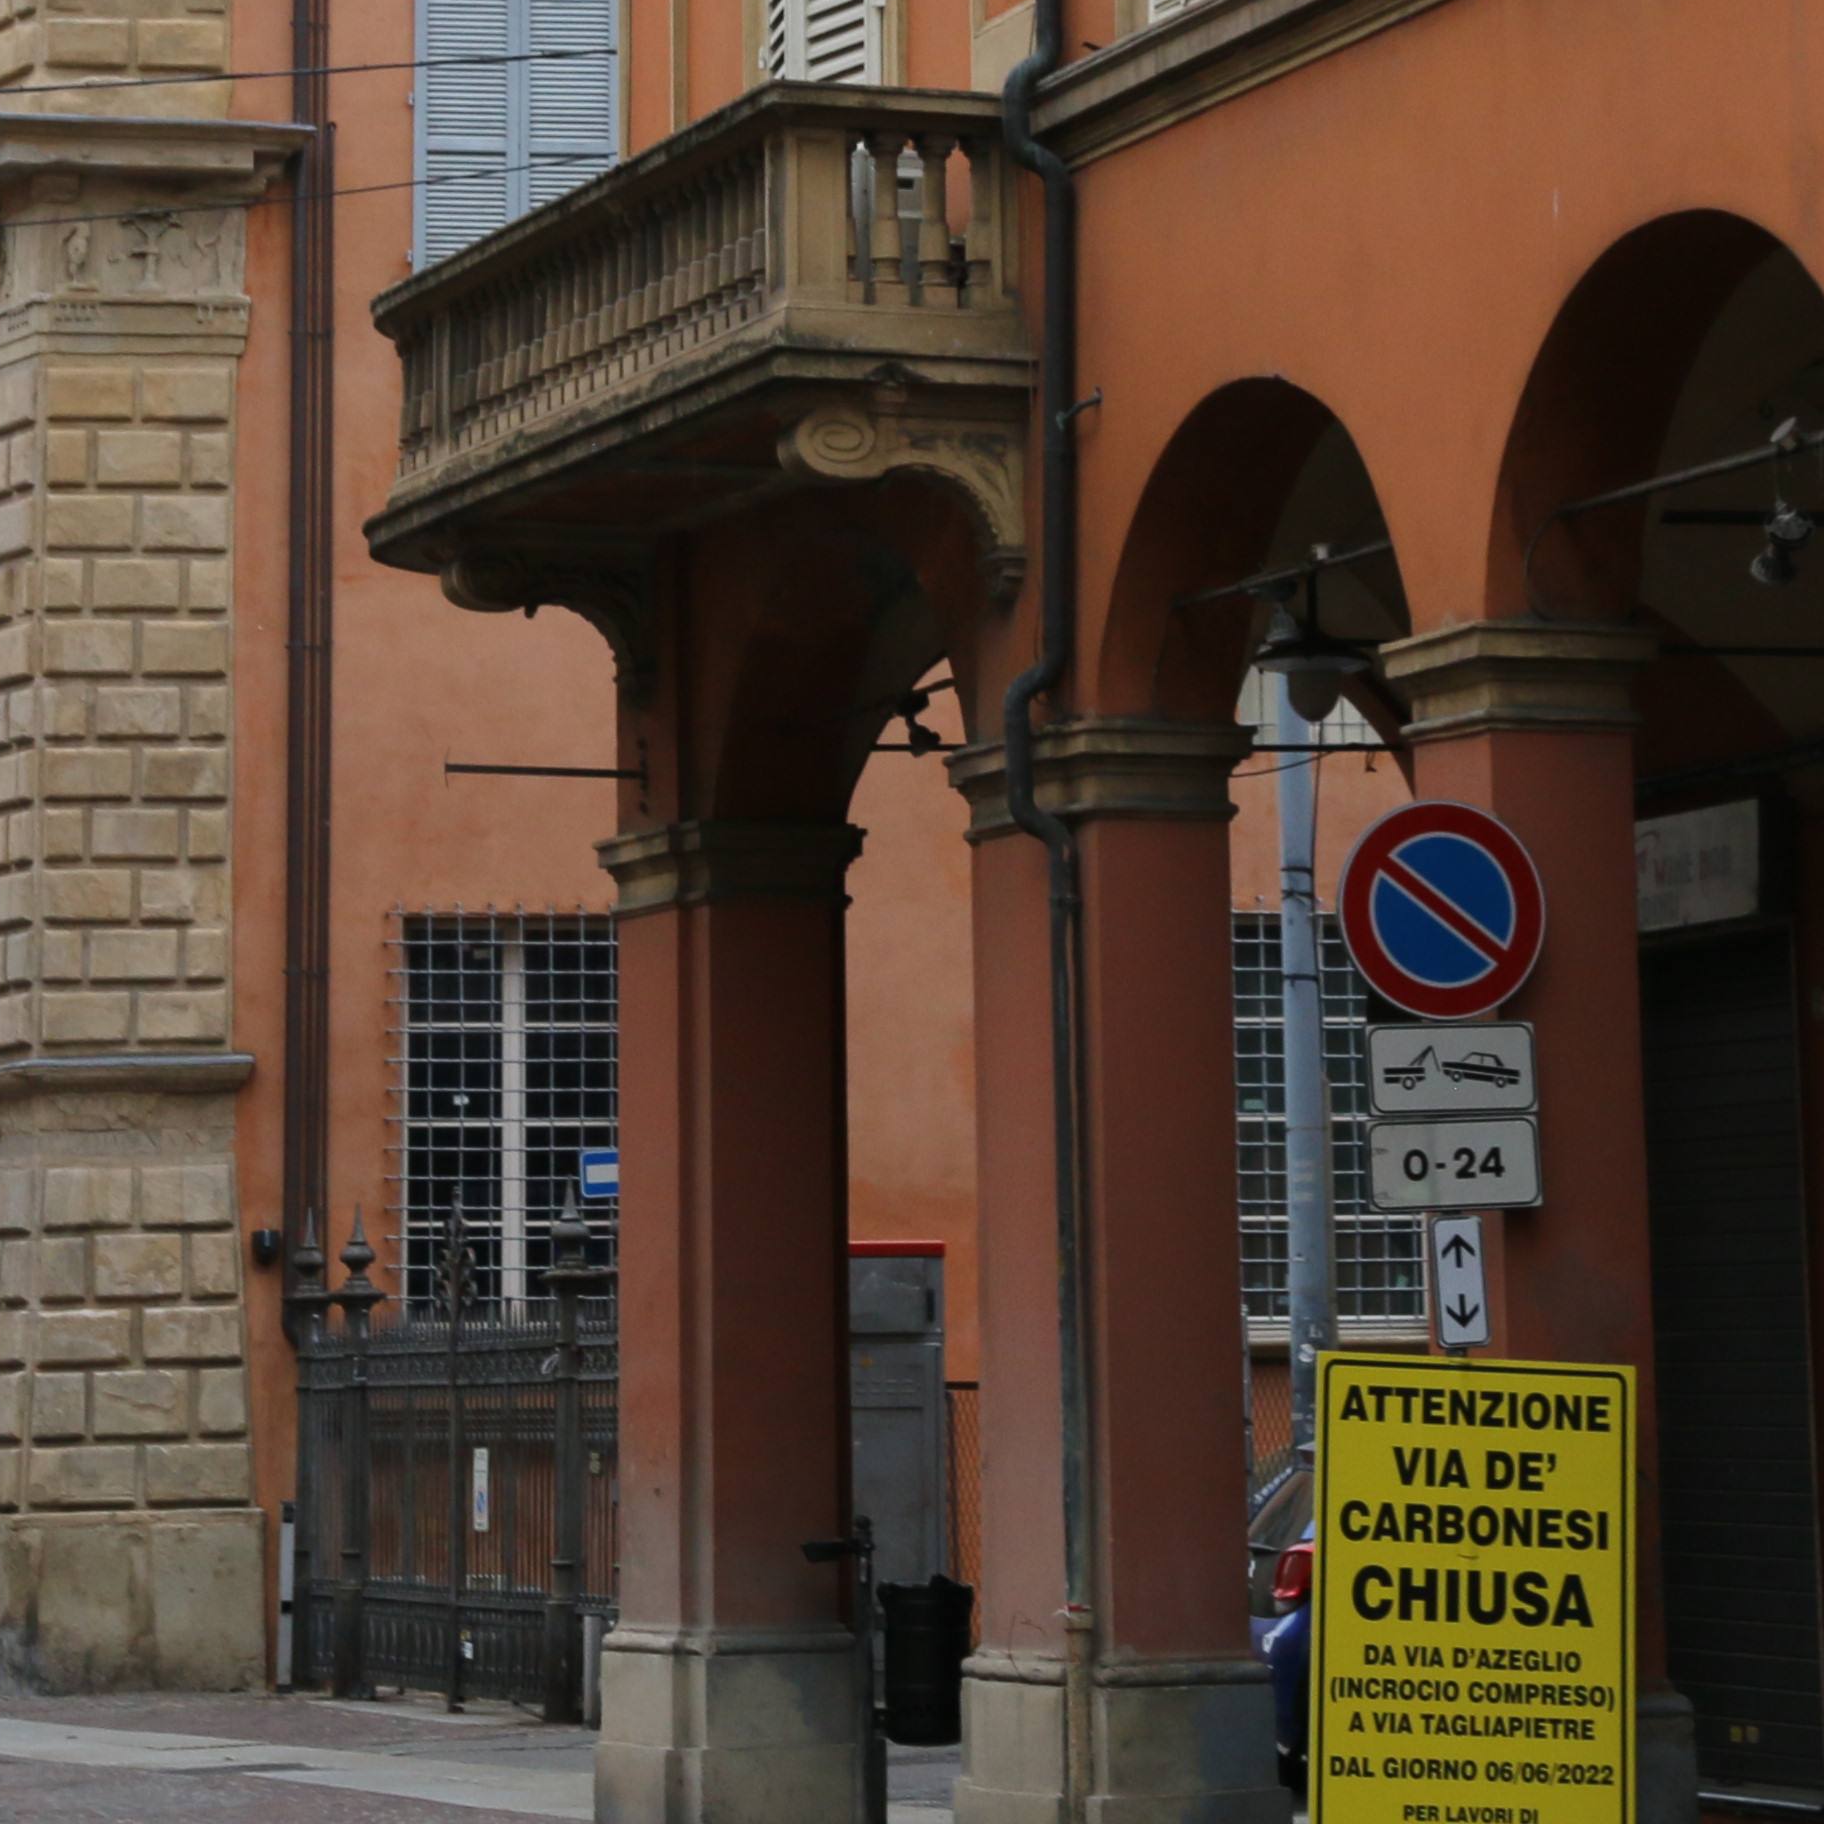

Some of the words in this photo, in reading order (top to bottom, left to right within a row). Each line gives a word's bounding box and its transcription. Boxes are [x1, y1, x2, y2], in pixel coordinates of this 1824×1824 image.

[1340, 1384, 1611, 1433] ATTENZIONE
[1392, 1446, 1470, 1489] VIA
[1339, 1500, 1609, 1551] CARBONESI
[1352, 1564, 1594, 1628] CHIUSA
[1364, 1644, 1396, 1666] DA
[1404, 1646, 1445, 1668] VIA
[1452, 1647, 1581, 1673] D'AZEGLIO
[1330, 1677, 1460, 1702] (INCROCIO
[1468, 1681, 1615, 1712] COMPRESO)
[1349, 1711, 1365, 1733] A
[1372, 1712, 1413, 1734] VIA
[1420, 1713, 1596, 1741] TAGLIAPIETRE
[1329, 1755, 1375, 1778] DAL
[1382, 1757, 1478, 1781] GIORNO
[1485, 1761, 1614, 1786] 06/06/2022
[1403, 1804, 1440, 1822] PER
[1445, 1806, 1513, 1824] LAVORI
[1519, 1808, 1539, 1824] DI
